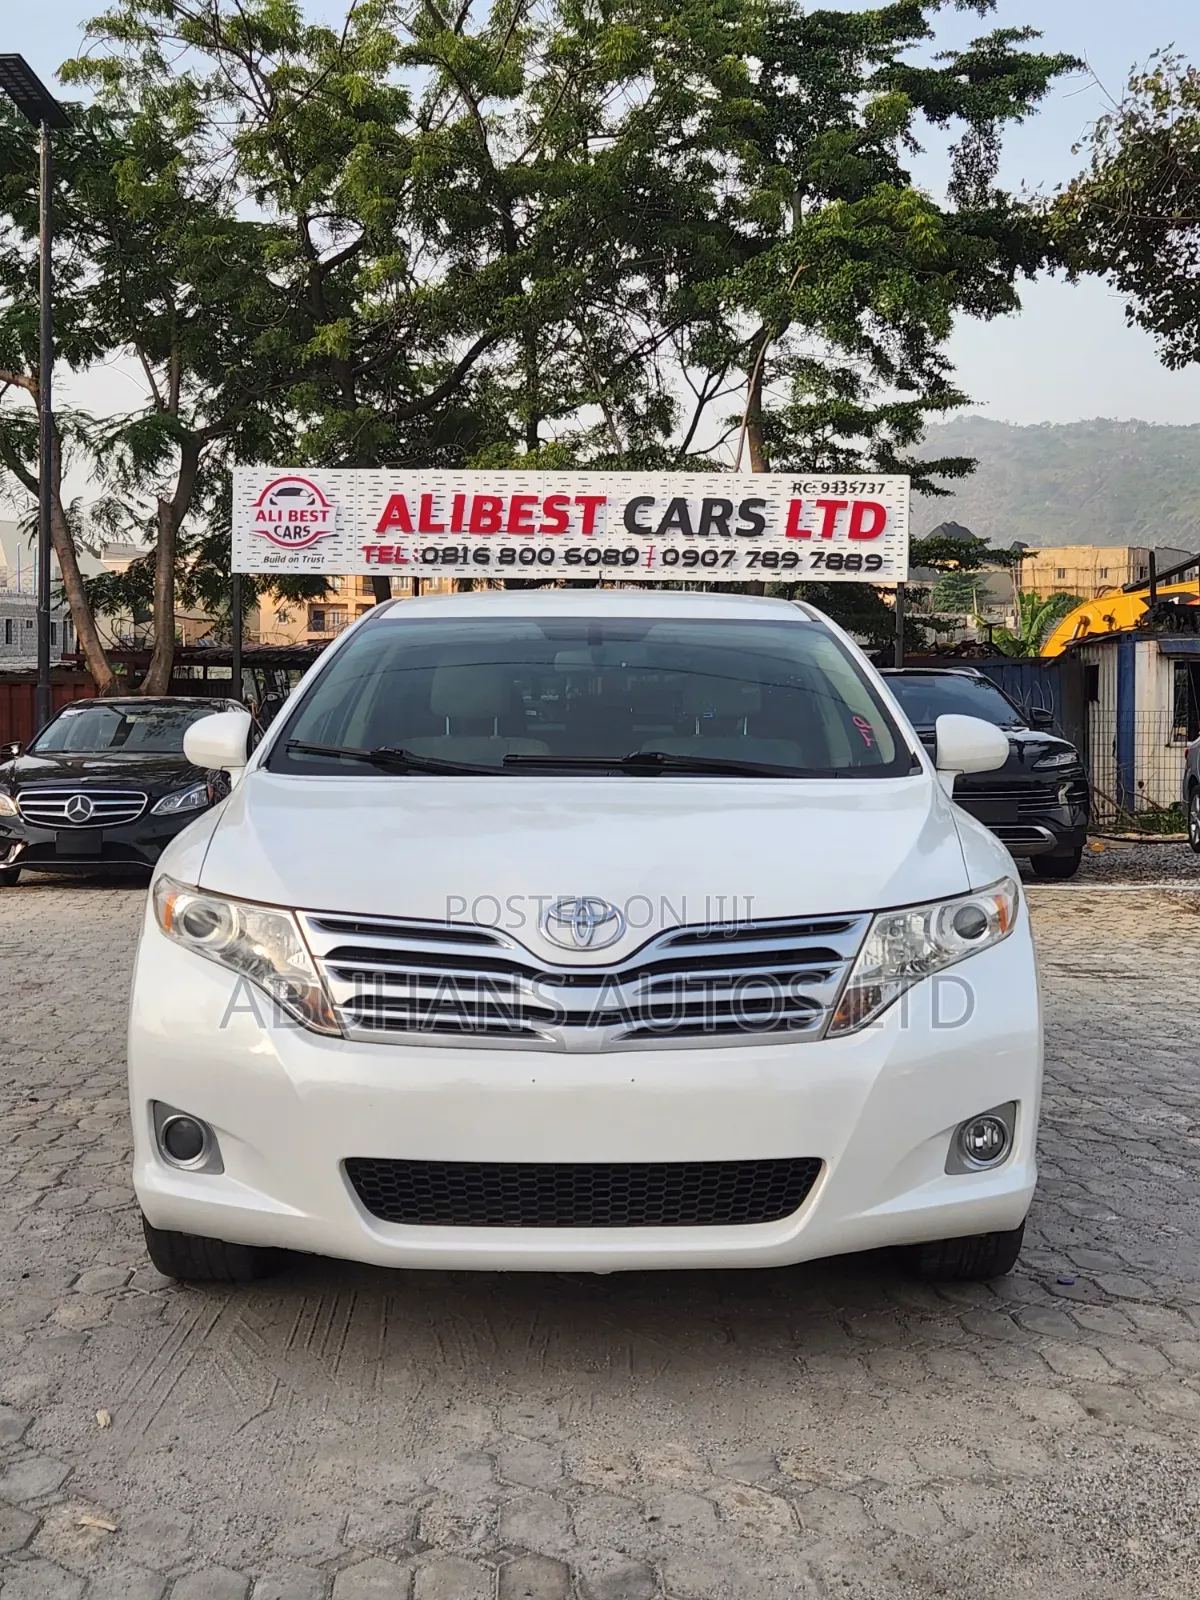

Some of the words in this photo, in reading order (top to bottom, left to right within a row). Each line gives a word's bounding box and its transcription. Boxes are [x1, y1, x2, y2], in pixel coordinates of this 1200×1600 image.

[255, 510, 282, 522] ALI
[288, 510, 329, 522] BEST
[376, 494, 606, 535] ALIBEST
[623, 496, 766, 537] CARS
[785, 499, 887, 541] LTD
[274, 525, 311, 540] CARS
[499, 547, 555, 567] 800
[564, 547, 639, 567] 6080
[662, 548, 737, 568] 0907
[745, 550, 800, 569] 789
[809, 551, 883, 572] 7889
